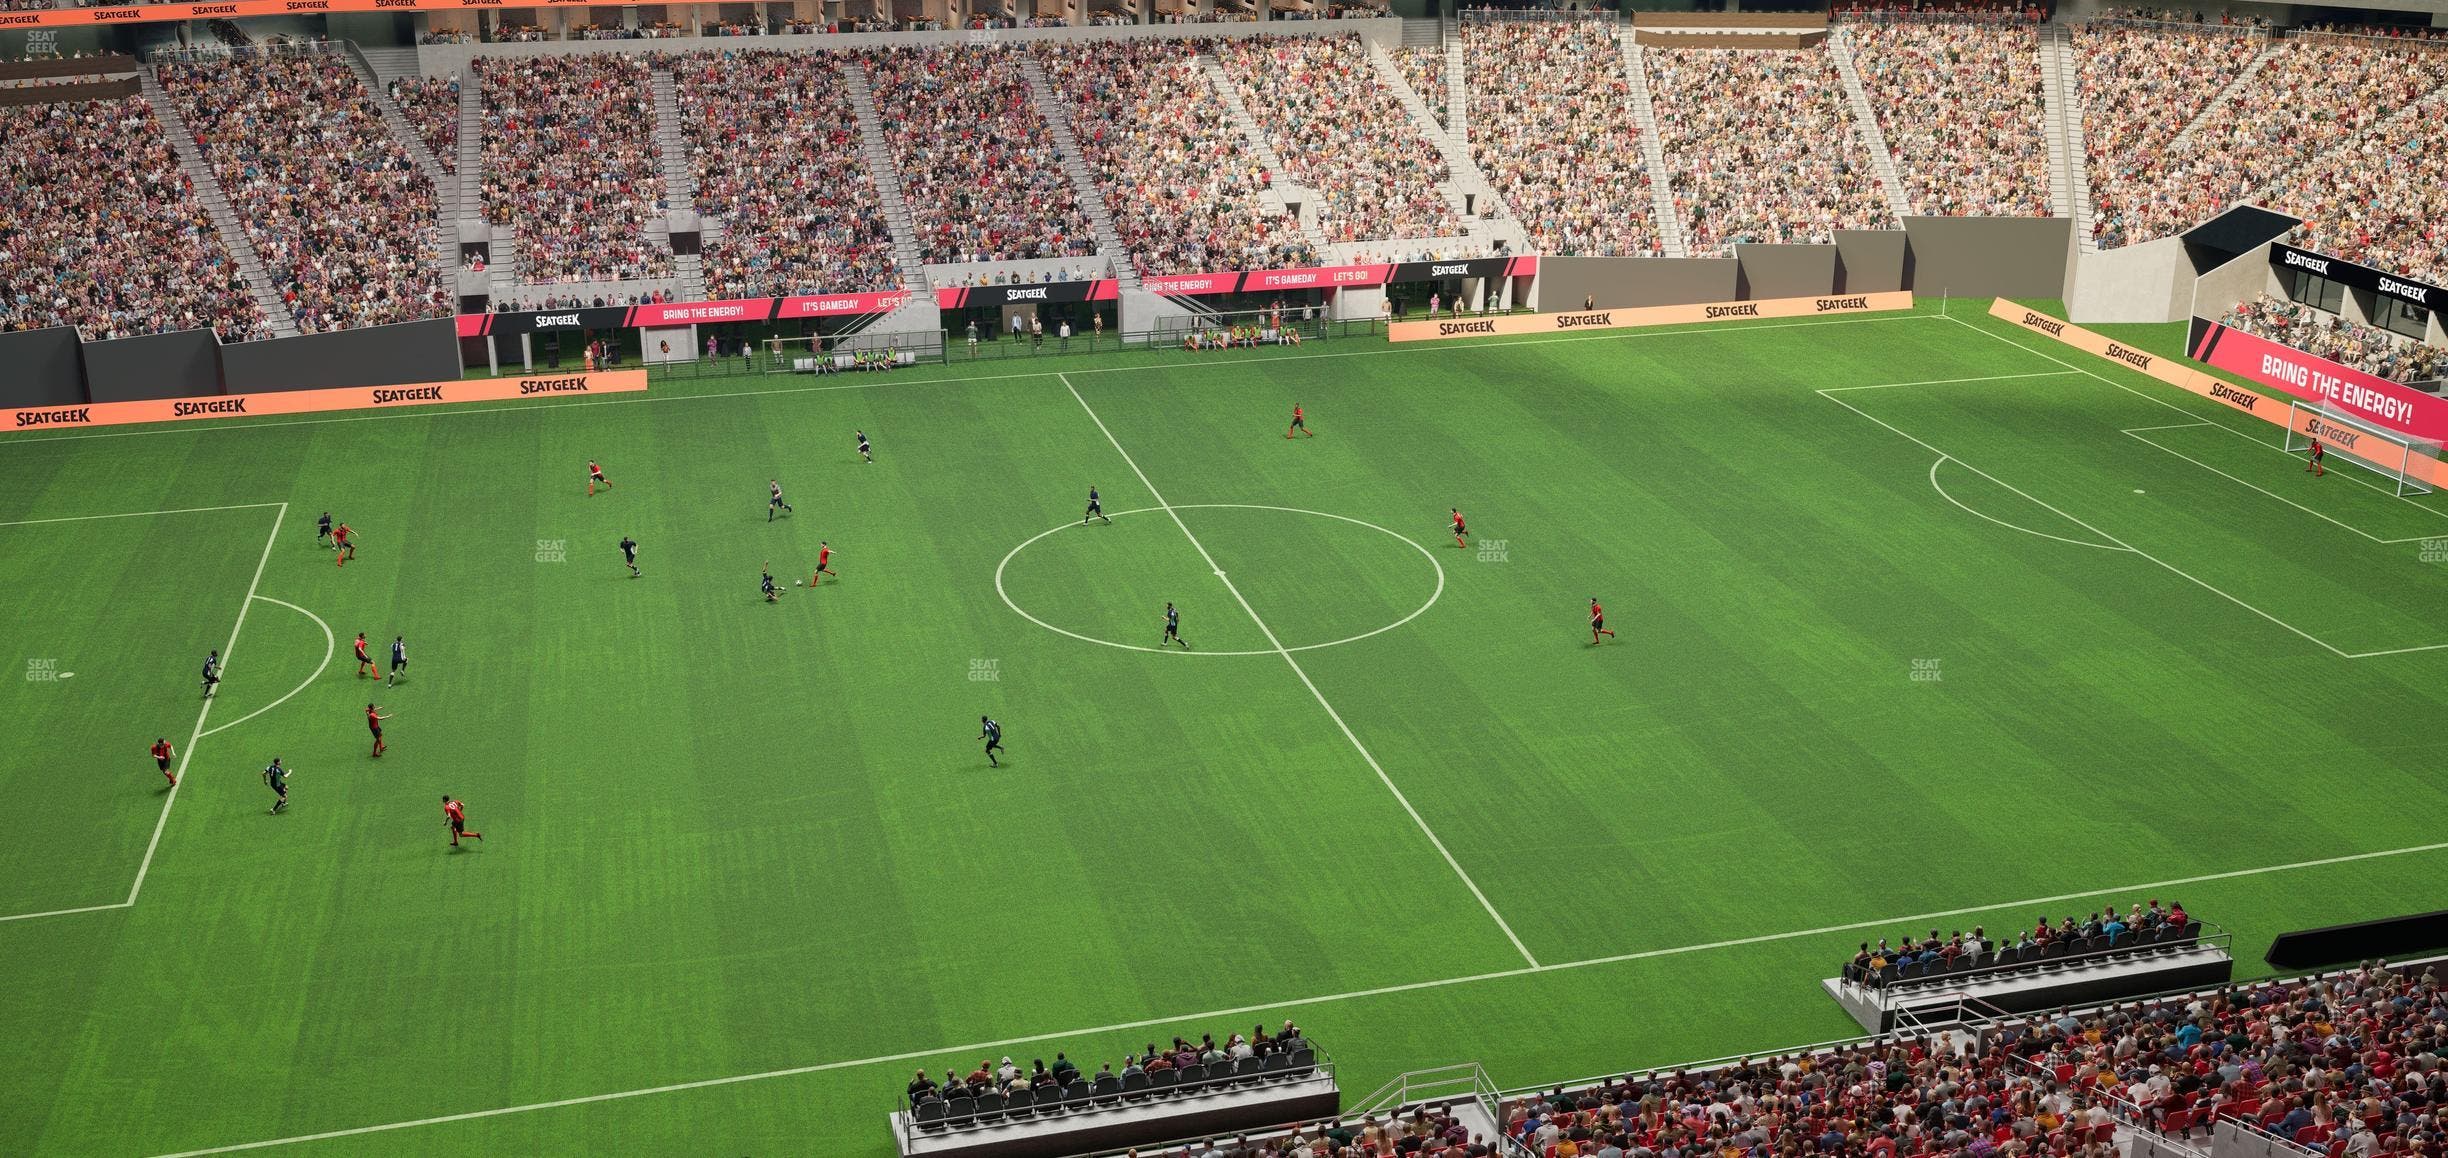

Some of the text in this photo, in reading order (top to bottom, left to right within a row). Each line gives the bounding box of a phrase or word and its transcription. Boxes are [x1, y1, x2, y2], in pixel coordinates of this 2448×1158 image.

[192, 5, 237, 15] SEATGEEK
[286, 1, 329, 10] SEATGEEK
[0, 14, 40, 25] EATGEEK
[94, 10, 141, 20] SEATGEEK
[1431, 263, 1469, 277] SEATGEEK
[2285, 250, 2329, 275] SEATGEEK
[1265, 273, 1317, 285] IT'S GAMEDAY
[1333, 271, 1368, 282] LET'S GO!
[1180, 279, 1213, 290] ENERGY!
[2378, 277, 2427, 303] SEATGEEK
[1007, 287, 1047, 301] SEATGEEK
[803, 301, 819, 312] IT'S
[820, 299, 859, 311] GAMEDAY
[1706, 303, 1759, 318] SEATGEEK
[1816, 297, 1869, 312] SEATGEEK
[535, 313, 581, 328] SEATGEEK
[663, 306, 744, 320] BRING THE ENERGY!
[1557, 312, 1612, 328] SEATGEEK
[1439, 319, 1496, 335] SEATGEEK
[2022, 312, 2065, 338] SEATGEEK
[2105, 343, 2152, 371] SEATGEEK
[520, 376, 588, 394] SEATGEEK
[2261, 353, 2414, 425] BRING THE ENERGY!
[373, 386, 442, 404] SEATGEEK
[2209, 382, 2258, 411] SEATGEEK
[174, 398, 246, 416] SEATGEEK
[16, 408, 90, 426] SEATGEEK
[2304, 418, 2361, 450] SEATGEEK
